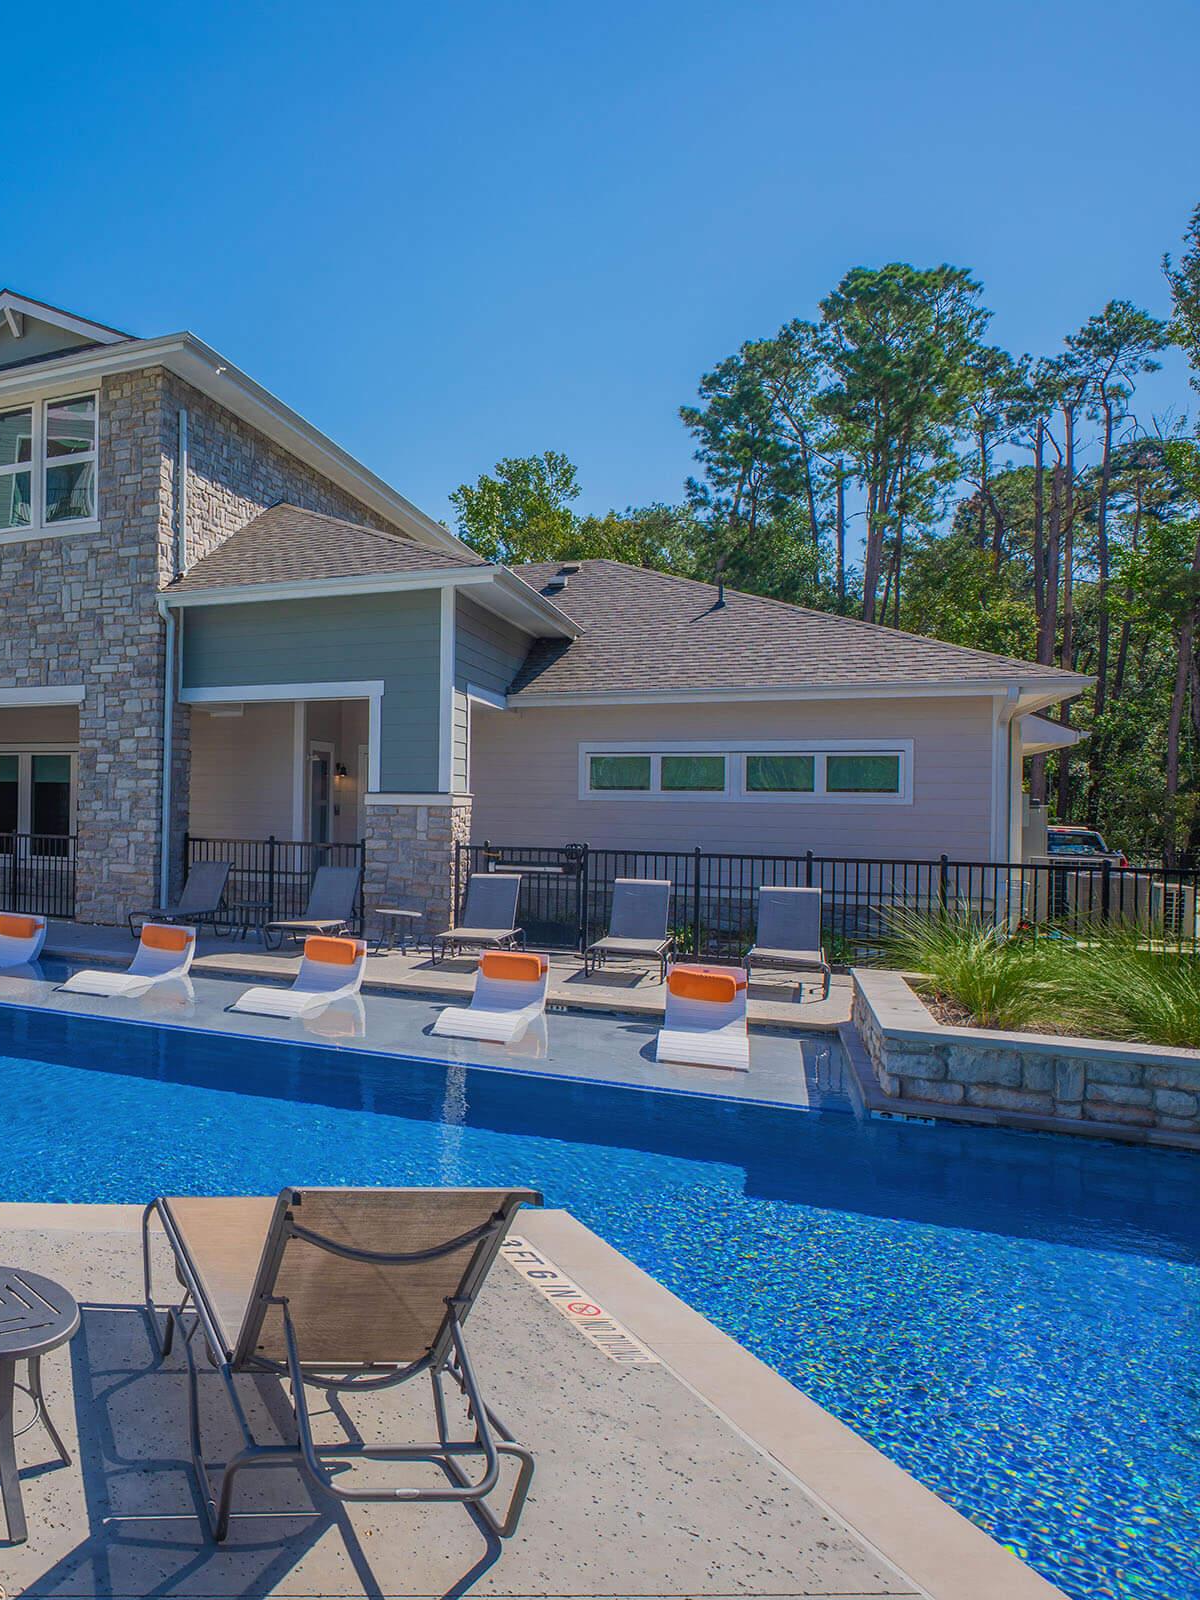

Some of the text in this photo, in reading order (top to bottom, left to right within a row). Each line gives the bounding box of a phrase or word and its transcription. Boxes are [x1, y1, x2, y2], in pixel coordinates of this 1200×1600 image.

[500, 1239, 583, 1298] 3 FT 6 IN
[577, 1321, 650, 1361] NO DIVING
